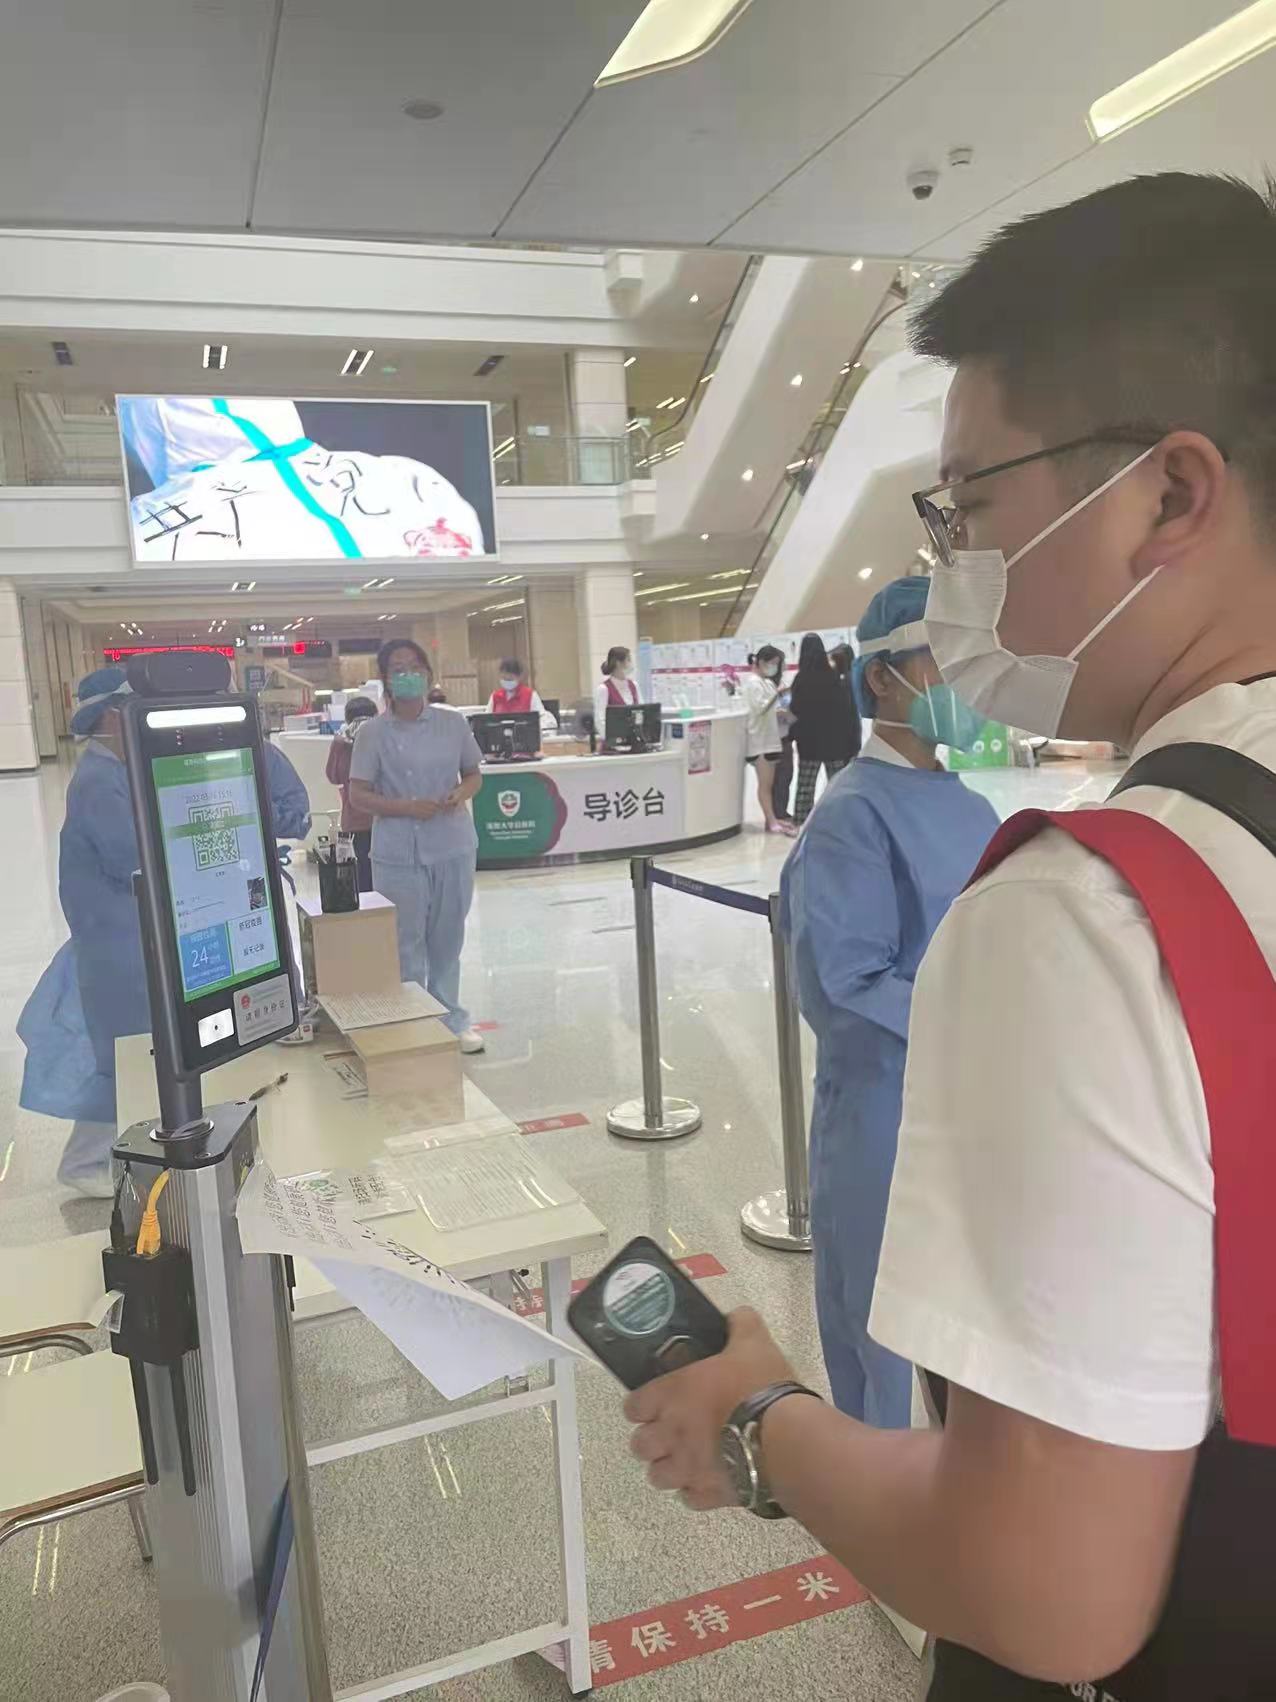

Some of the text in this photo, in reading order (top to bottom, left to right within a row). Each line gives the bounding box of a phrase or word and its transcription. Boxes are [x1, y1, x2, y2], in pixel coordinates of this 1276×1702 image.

[583, 787, 665, 822] 导诊台
[191, 946, 208, 968] 24
